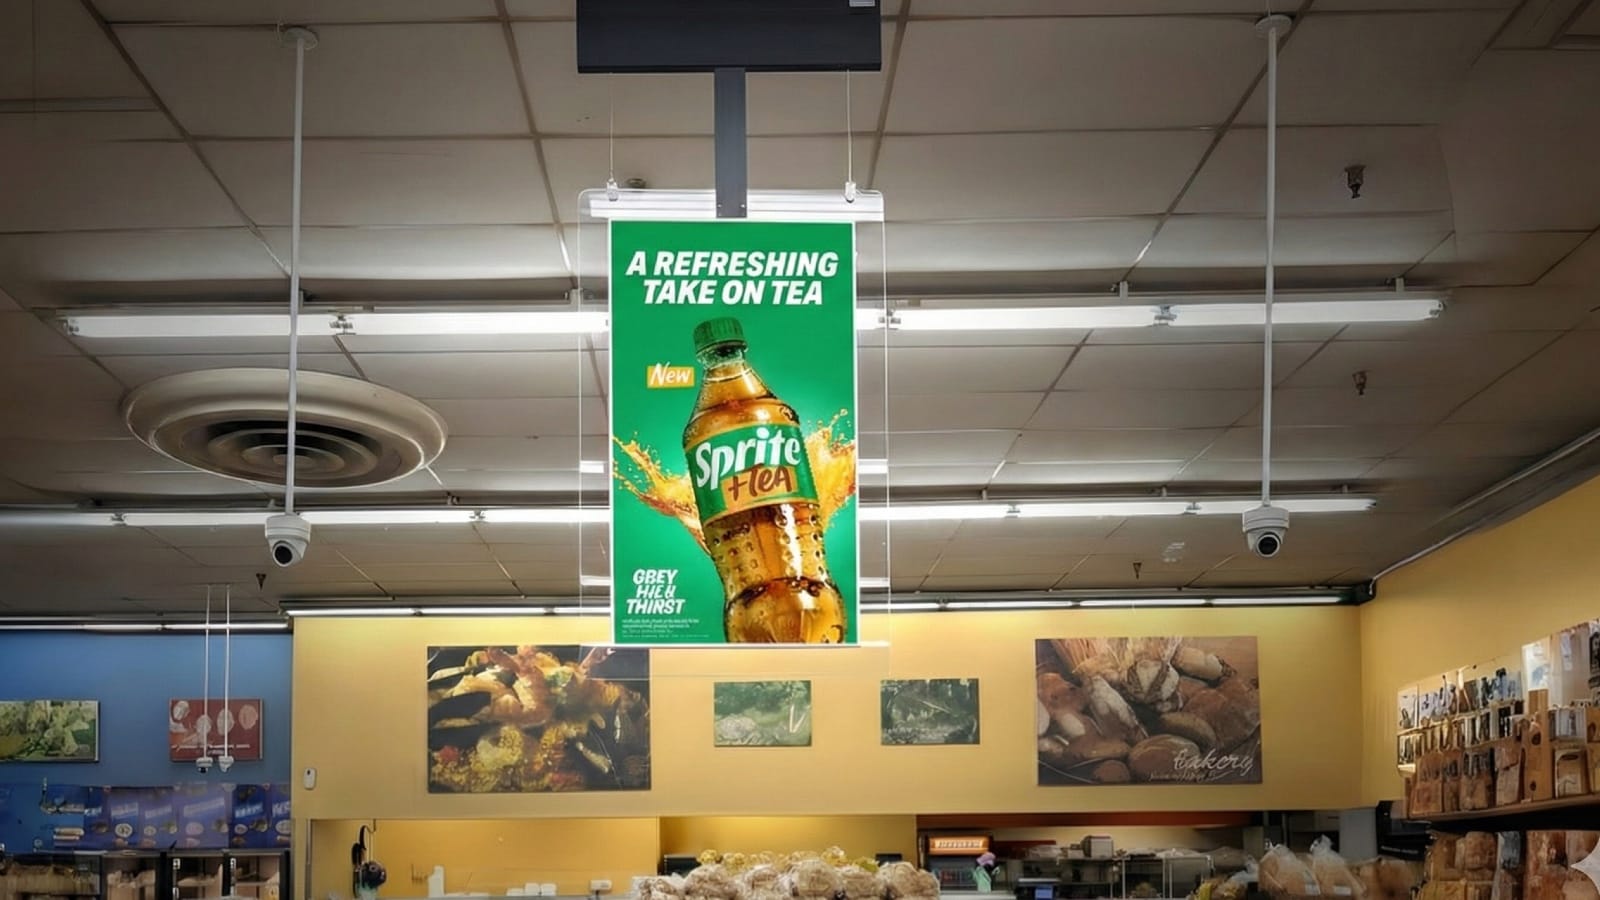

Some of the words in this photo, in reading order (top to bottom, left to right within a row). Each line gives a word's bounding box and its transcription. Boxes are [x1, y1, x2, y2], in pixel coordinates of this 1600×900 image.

[626, 251, 646, 276] A
[653, 251, 838, 277] REFRESHING
[644, 279, 717, 305] TAKE
[721, 279, 766, 305] ON
[771, 280, 822, 305] TEA
[650, 361, 691, 386] New
[695, 426, 801, 491] Sprite
[626, 598, 686, 614] THIRST
